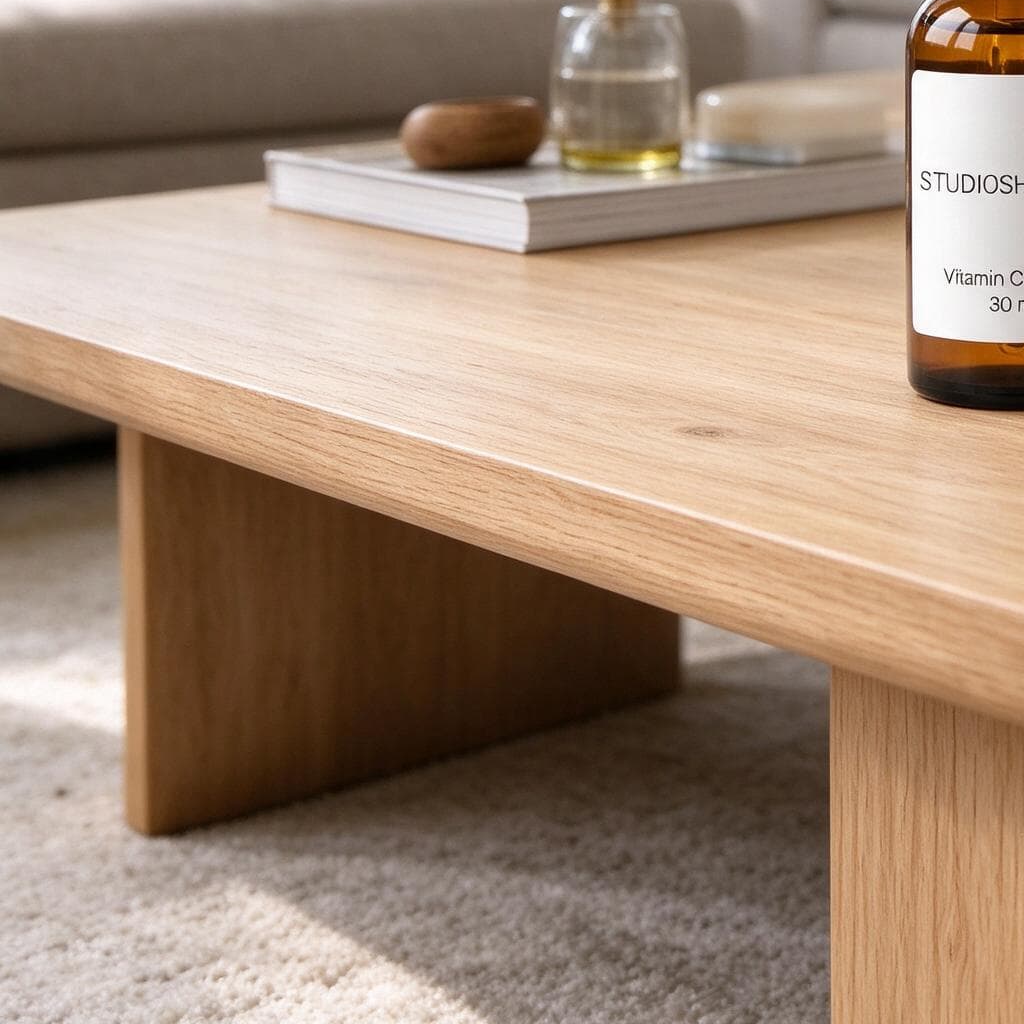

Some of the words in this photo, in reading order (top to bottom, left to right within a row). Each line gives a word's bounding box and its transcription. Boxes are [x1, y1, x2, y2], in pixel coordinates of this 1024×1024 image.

[943, 268, 1005, 287] Vitamin
[1009, 269, 1024, 287] C
[989, 296, 1013, 313] 30
